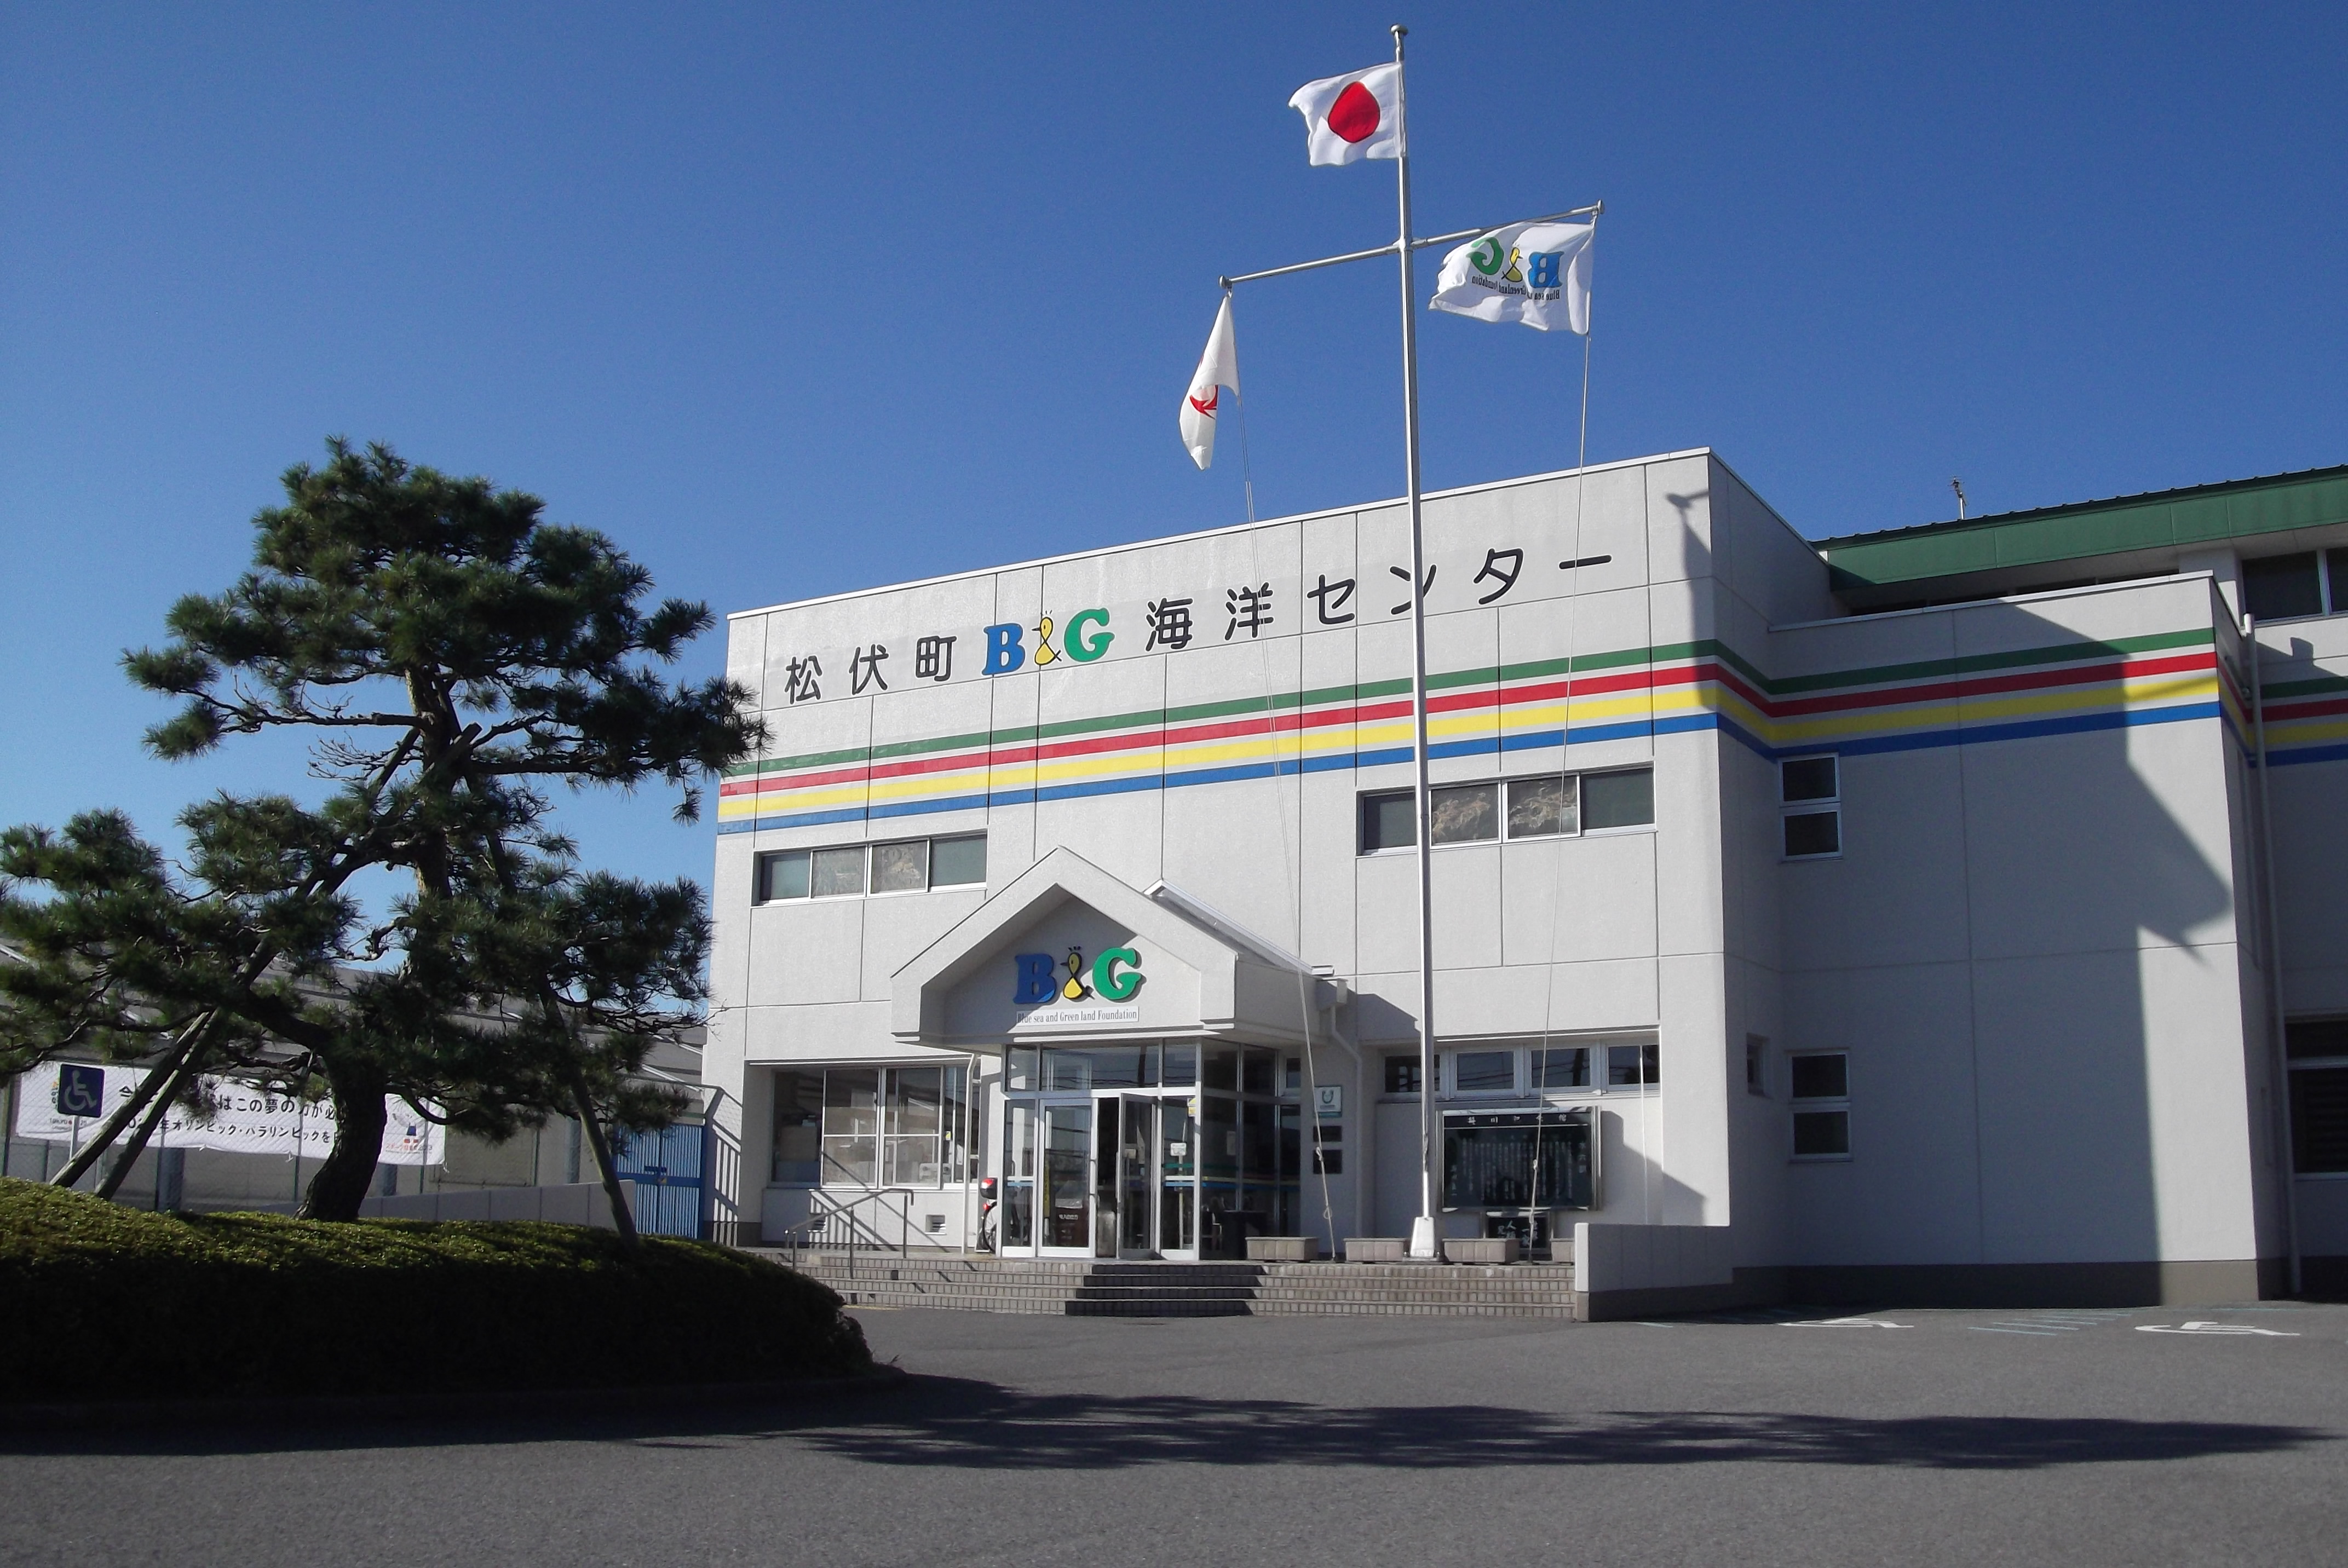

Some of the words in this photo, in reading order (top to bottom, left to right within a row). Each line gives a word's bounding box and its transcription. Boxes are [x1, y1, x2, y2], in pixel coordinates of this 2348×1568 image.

[1013, 946, 1144, 1004] B&G
[1017, 1012, 1032, 1023] Blue
[1045, 1012, 1058, 1022] and
[1060, 1011, 1079, 1022] Green
[1080, 1010, 1096, 1021] land
[1097, 1008, 1137, 1021] Foundation
